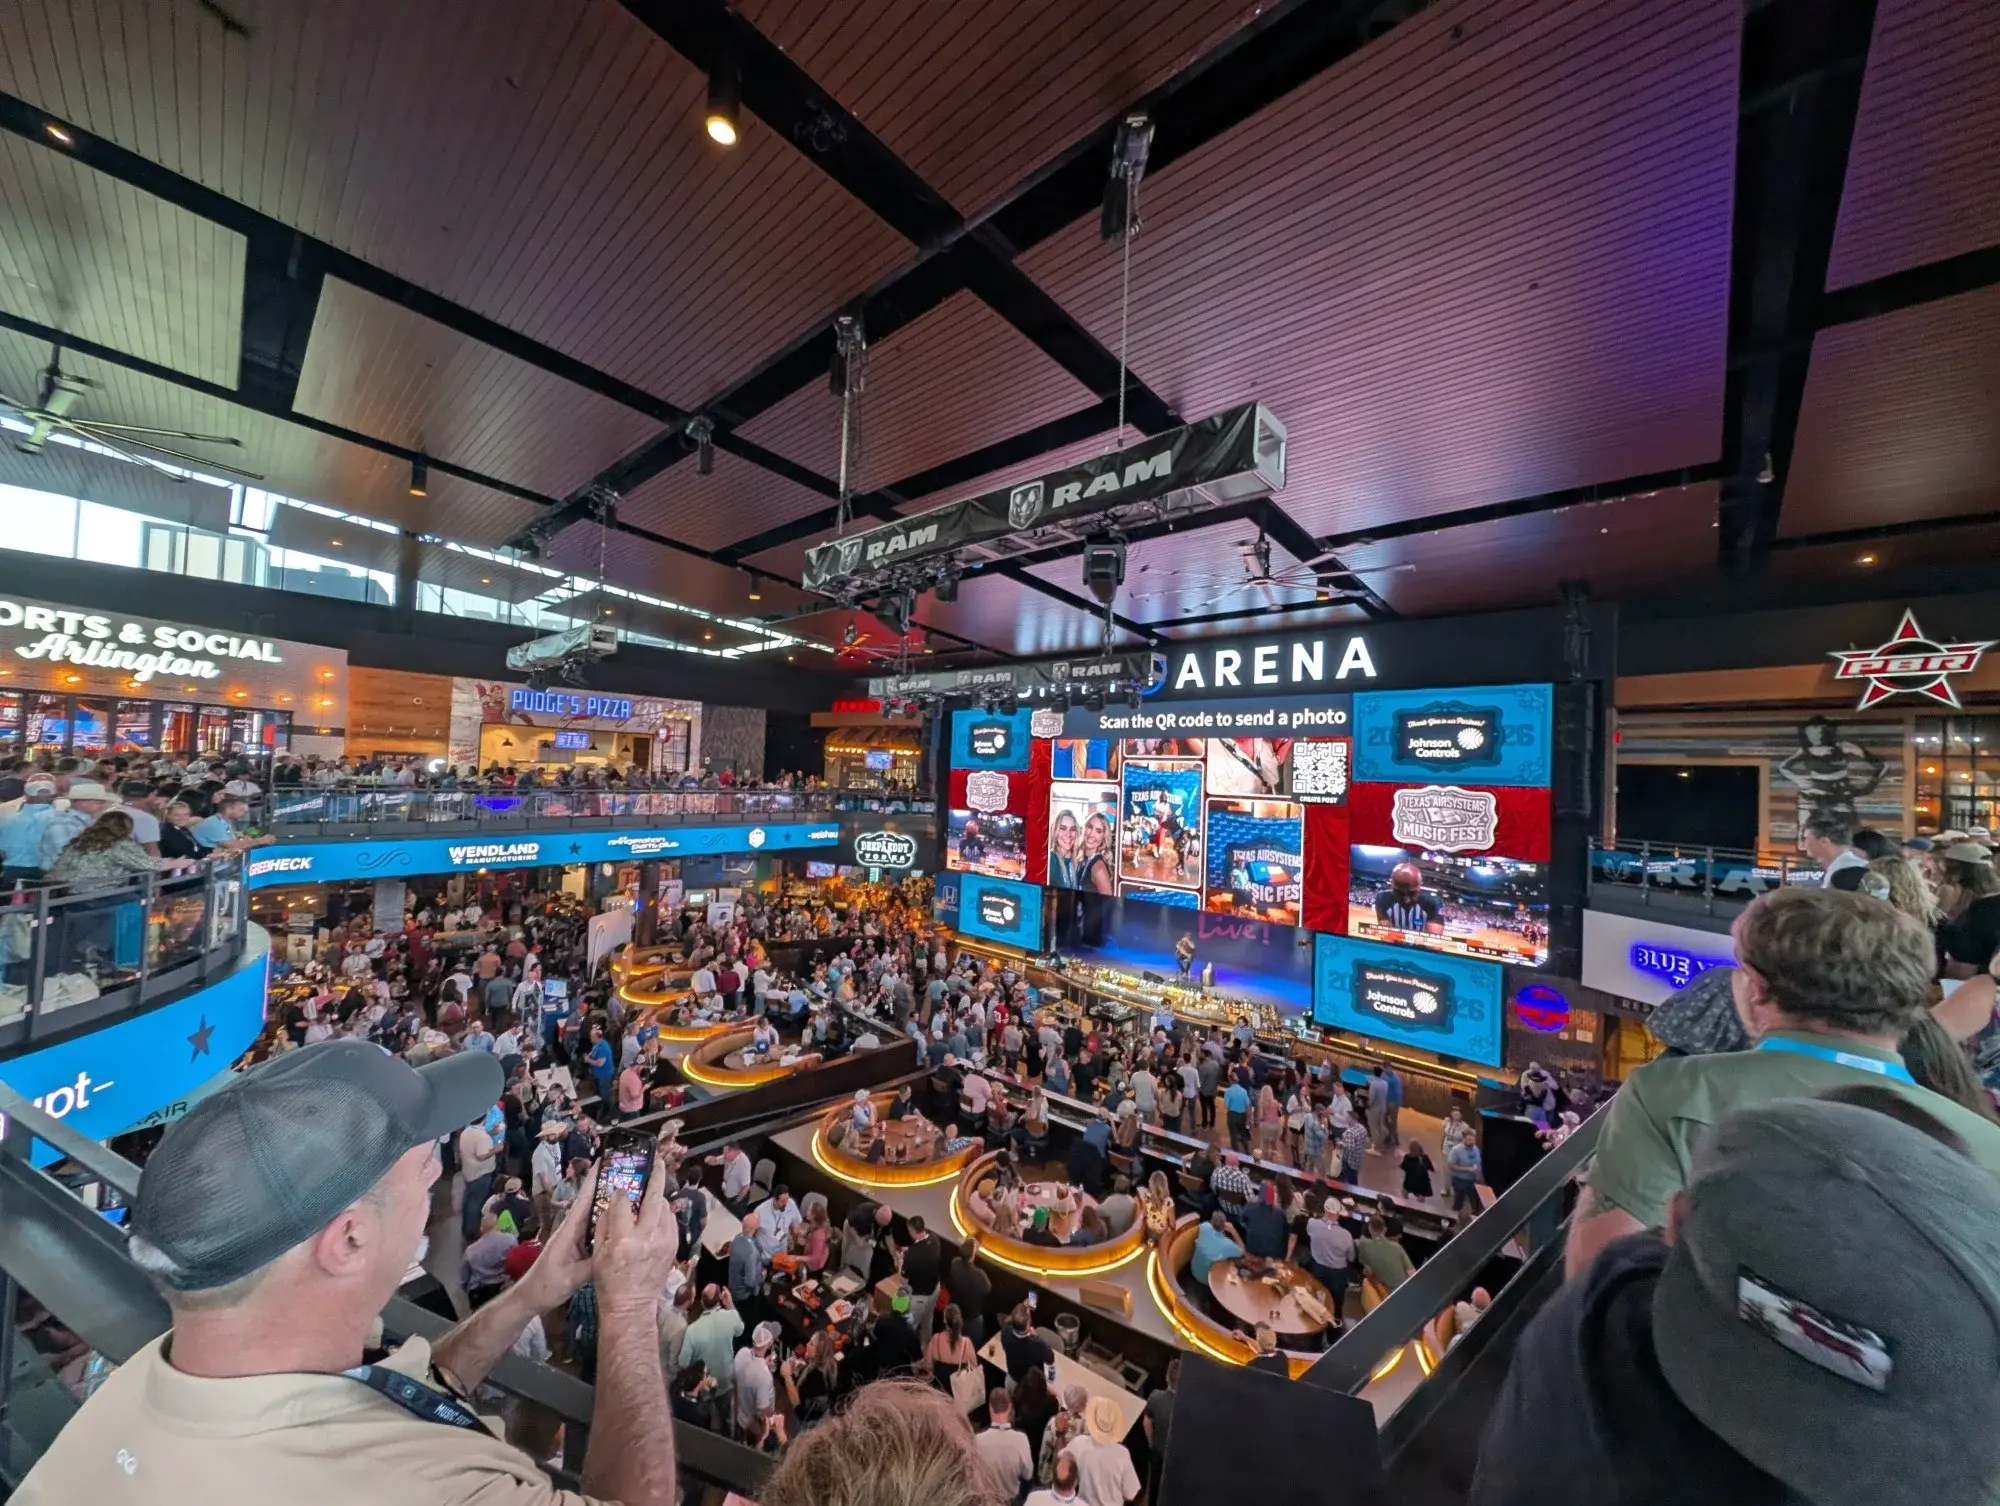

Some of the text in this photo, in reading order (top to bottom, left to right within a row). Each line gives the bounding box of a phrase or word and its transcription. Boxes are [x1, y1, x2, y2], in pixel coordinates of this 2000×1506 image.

[1051, 451, 1172, 508] RAM
[866, 524, 938, 561] RAM
[118, 623, 147, 644] &
[153, 626, 282, 663] SOCIAL
[15, 633, 220, 681] Arlington
[1175, 637, 1377, 689] ARENA
[1848, 654, 1972, 674] PBR
[973, 672, 1011, 684] RAM
[1072, 663, 1122, 677] RAM
[899, 680, 930, 690] RAM
[512, 690, 579, 715] PUDGE'S
[587, 697, 630, 719] PIZZA
[1100, 709, 1346, 729] Scan the QR code to send a photo
[1408, 738, 1452, 749] Johnson
[1416, 748, 1460, 758] Controls
[1403, 796, 1486, 812] TEXAS AIRSYSTEMS
[1403, 822, 1484, 842] MUSIC FEST
[449, 843, 539, 858] WENDLAND
[466, 855, 537, 864] MANUFACTURING
[1246, 881, 1301, 903] SIC FES
[1200, 914, 1270, 945] Live!
[1636, 947, 1690, 976] BLUE
[1367, 989, 1408, 1007] Johnson
[1374, 1001, 1415, 1019] Controls
[434, 1402, 458, 1421] MUSIC
